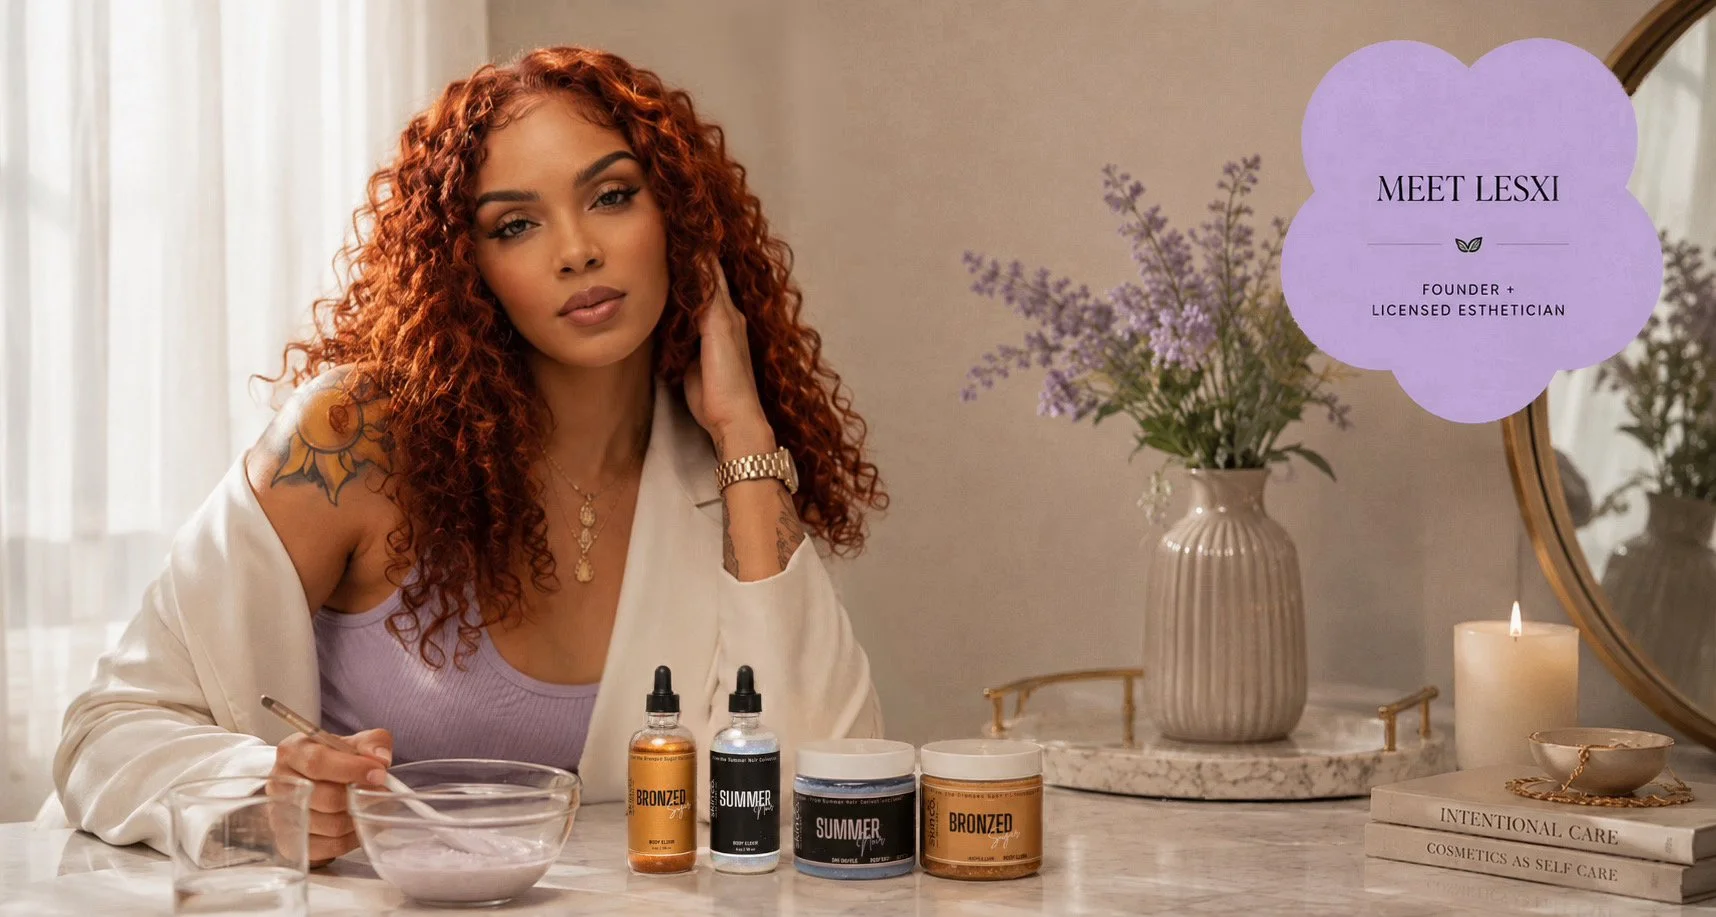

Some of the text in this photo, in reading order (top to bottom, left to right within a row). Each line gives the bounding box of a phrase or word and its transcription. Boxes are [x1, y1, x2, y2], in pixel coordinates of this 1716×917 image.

[636, 789, 686, 807] BRONZED
[719, 789, 771, 808] SUMMER
[816, 817, 880, 841] SUMMER
[949, 812, 1013, 835] BRONZED
[1440, 807, 1620, 847] INTENTIONAL CARE
[1426, 842, 1619, 882] COSMETICS AS SELF CARE
